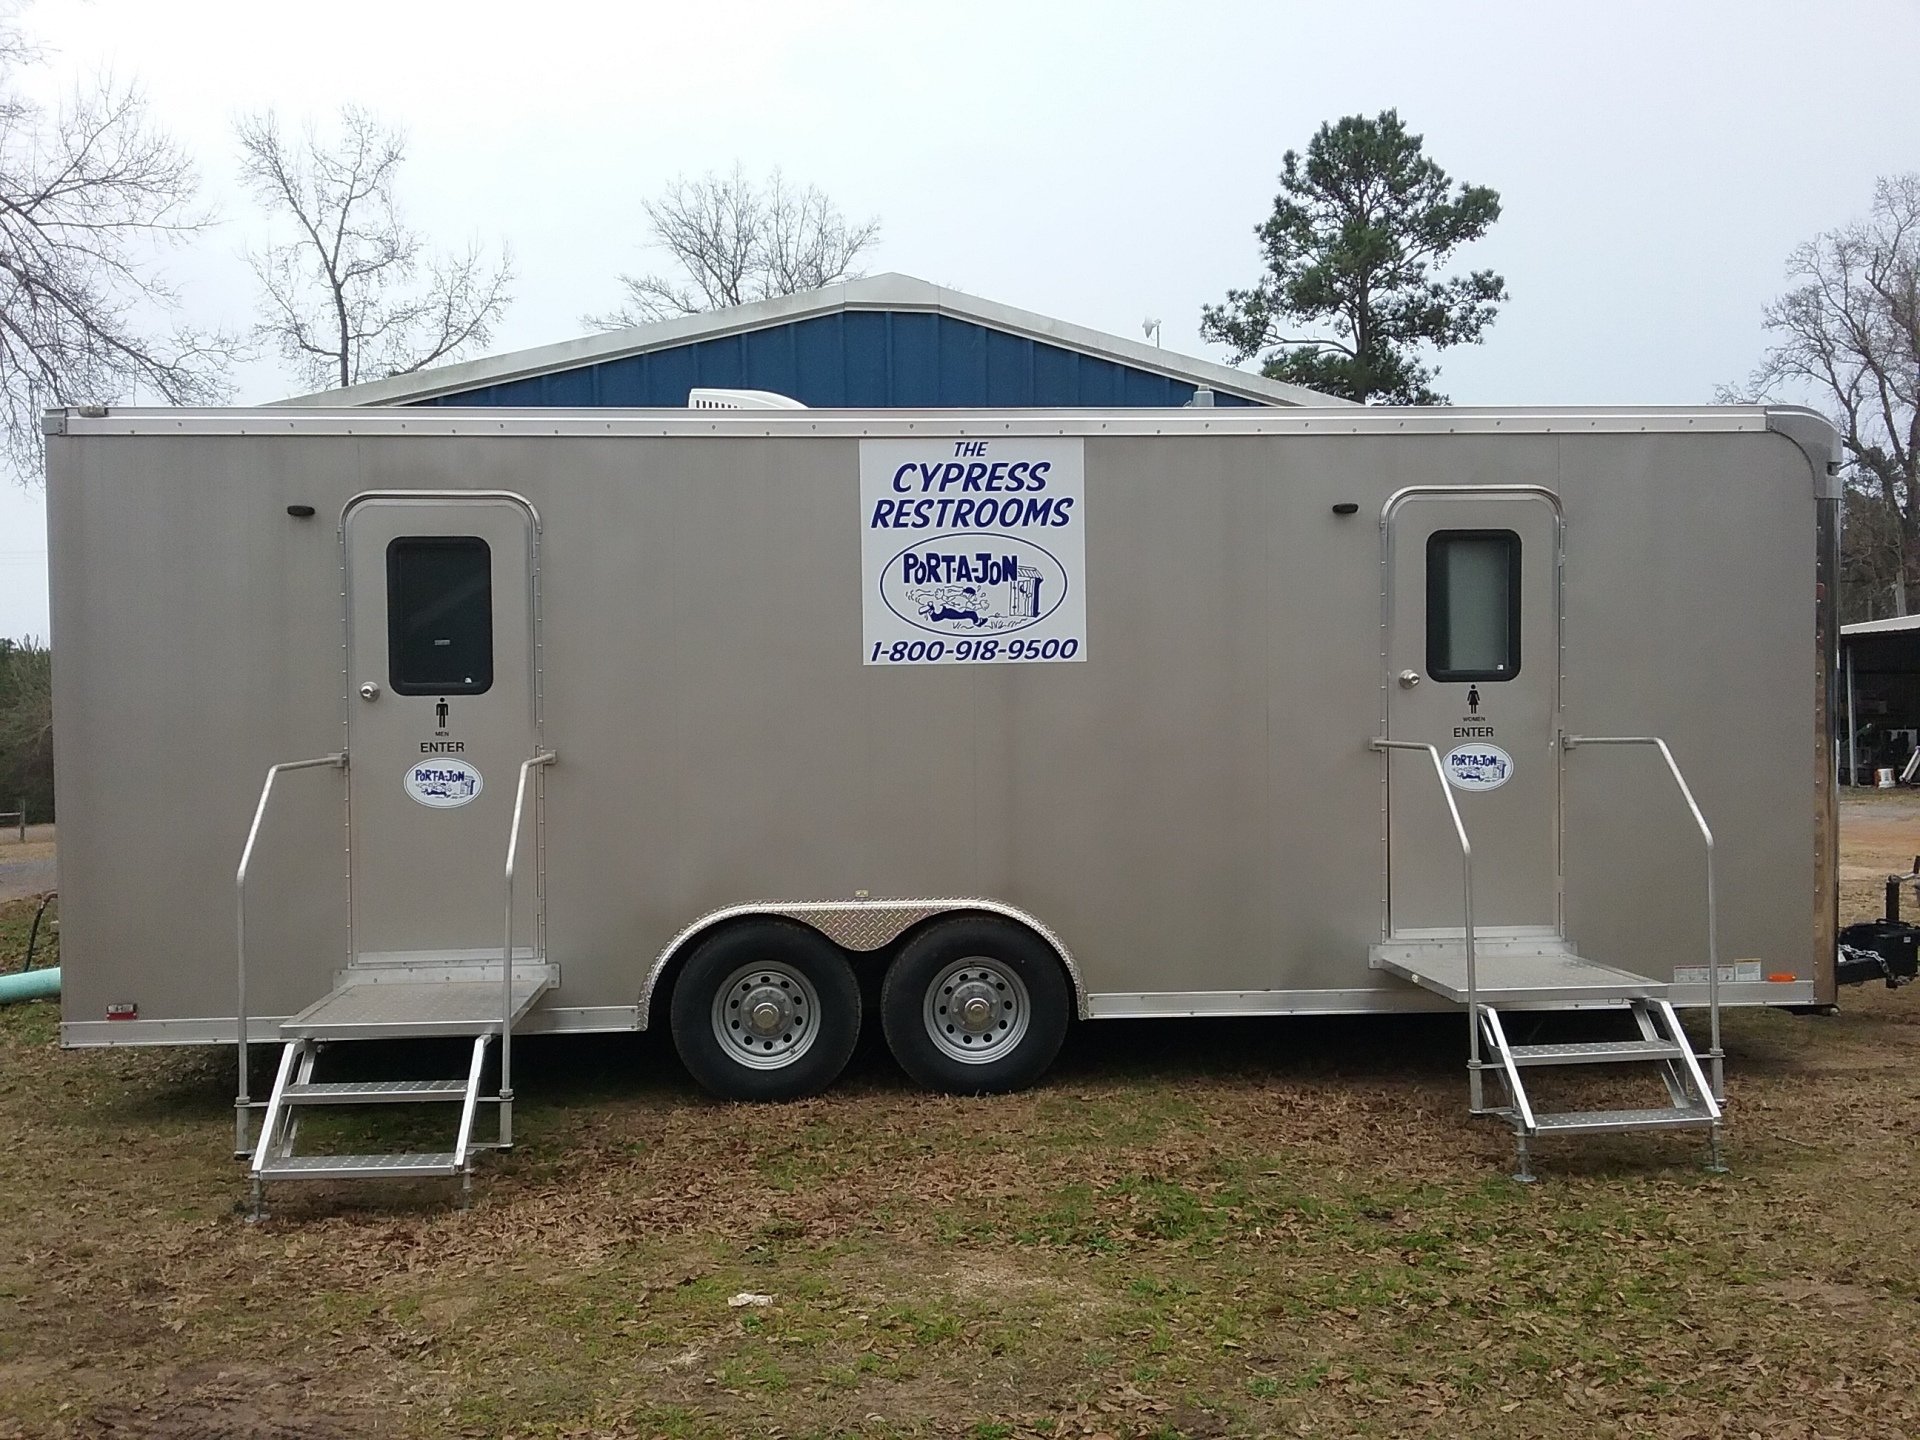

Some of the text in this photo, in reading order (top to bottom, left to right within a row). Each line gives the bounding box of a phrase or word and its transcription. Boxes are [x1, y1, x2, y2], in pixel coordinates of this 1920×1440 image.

[954, 441, 989, 457] THE
[892, 462, 1051, 493] CYPRESS
[870, 497, 1074, 529] RESTROOMS
[870, 638, 1079, 662] 1-800-918-9500
[1453, 727, 1494, 738] ENTER
[420, 741, 465, 753] ENTER
